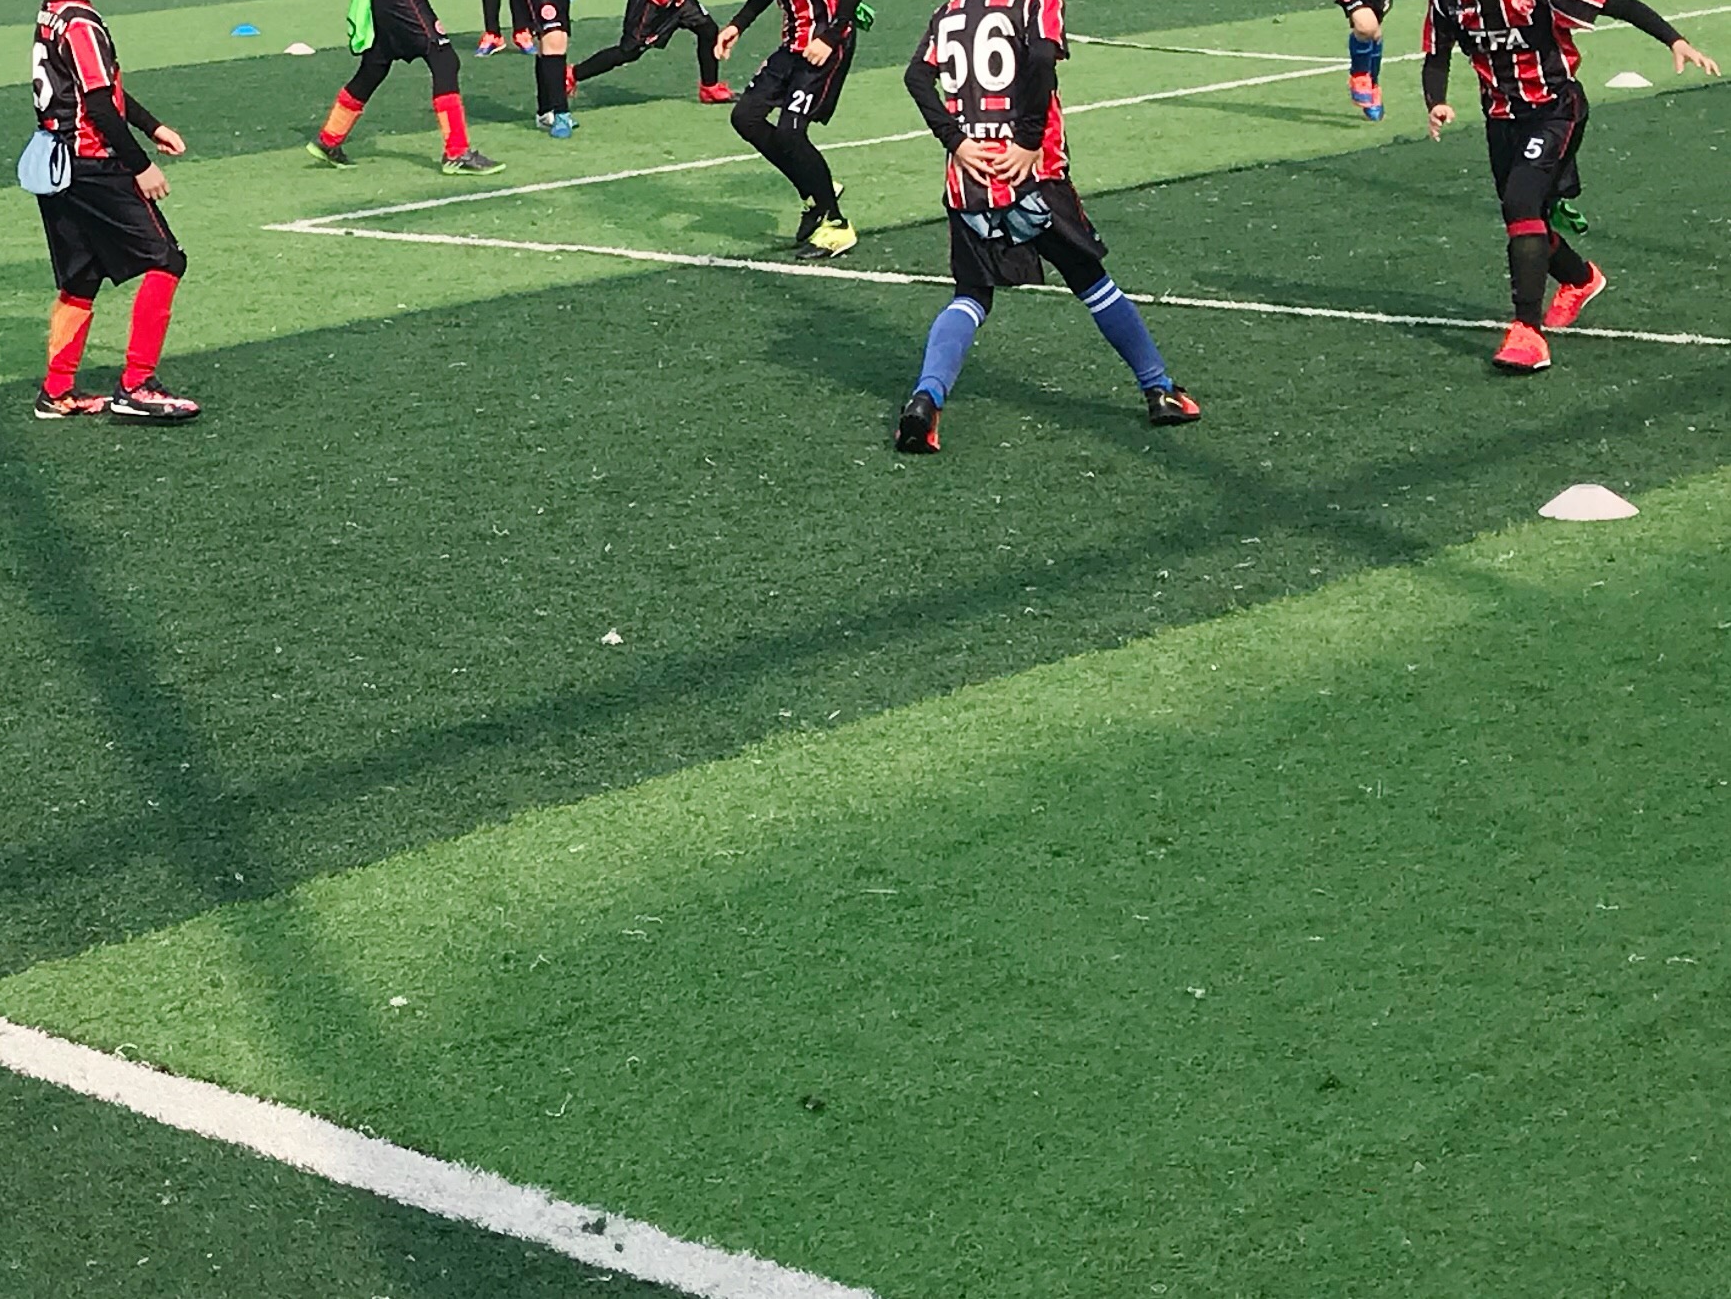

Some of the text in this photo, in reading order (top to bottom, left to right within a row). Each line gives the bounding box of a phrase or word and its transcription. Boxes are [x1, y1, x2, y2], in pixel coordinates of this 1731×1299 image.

[1468, 27, 1530, 51] TFA
[936, 11, 1016, 94] 56
[787, 89, 814, 115] 21
[1523, 137, 1545, 160] 5
